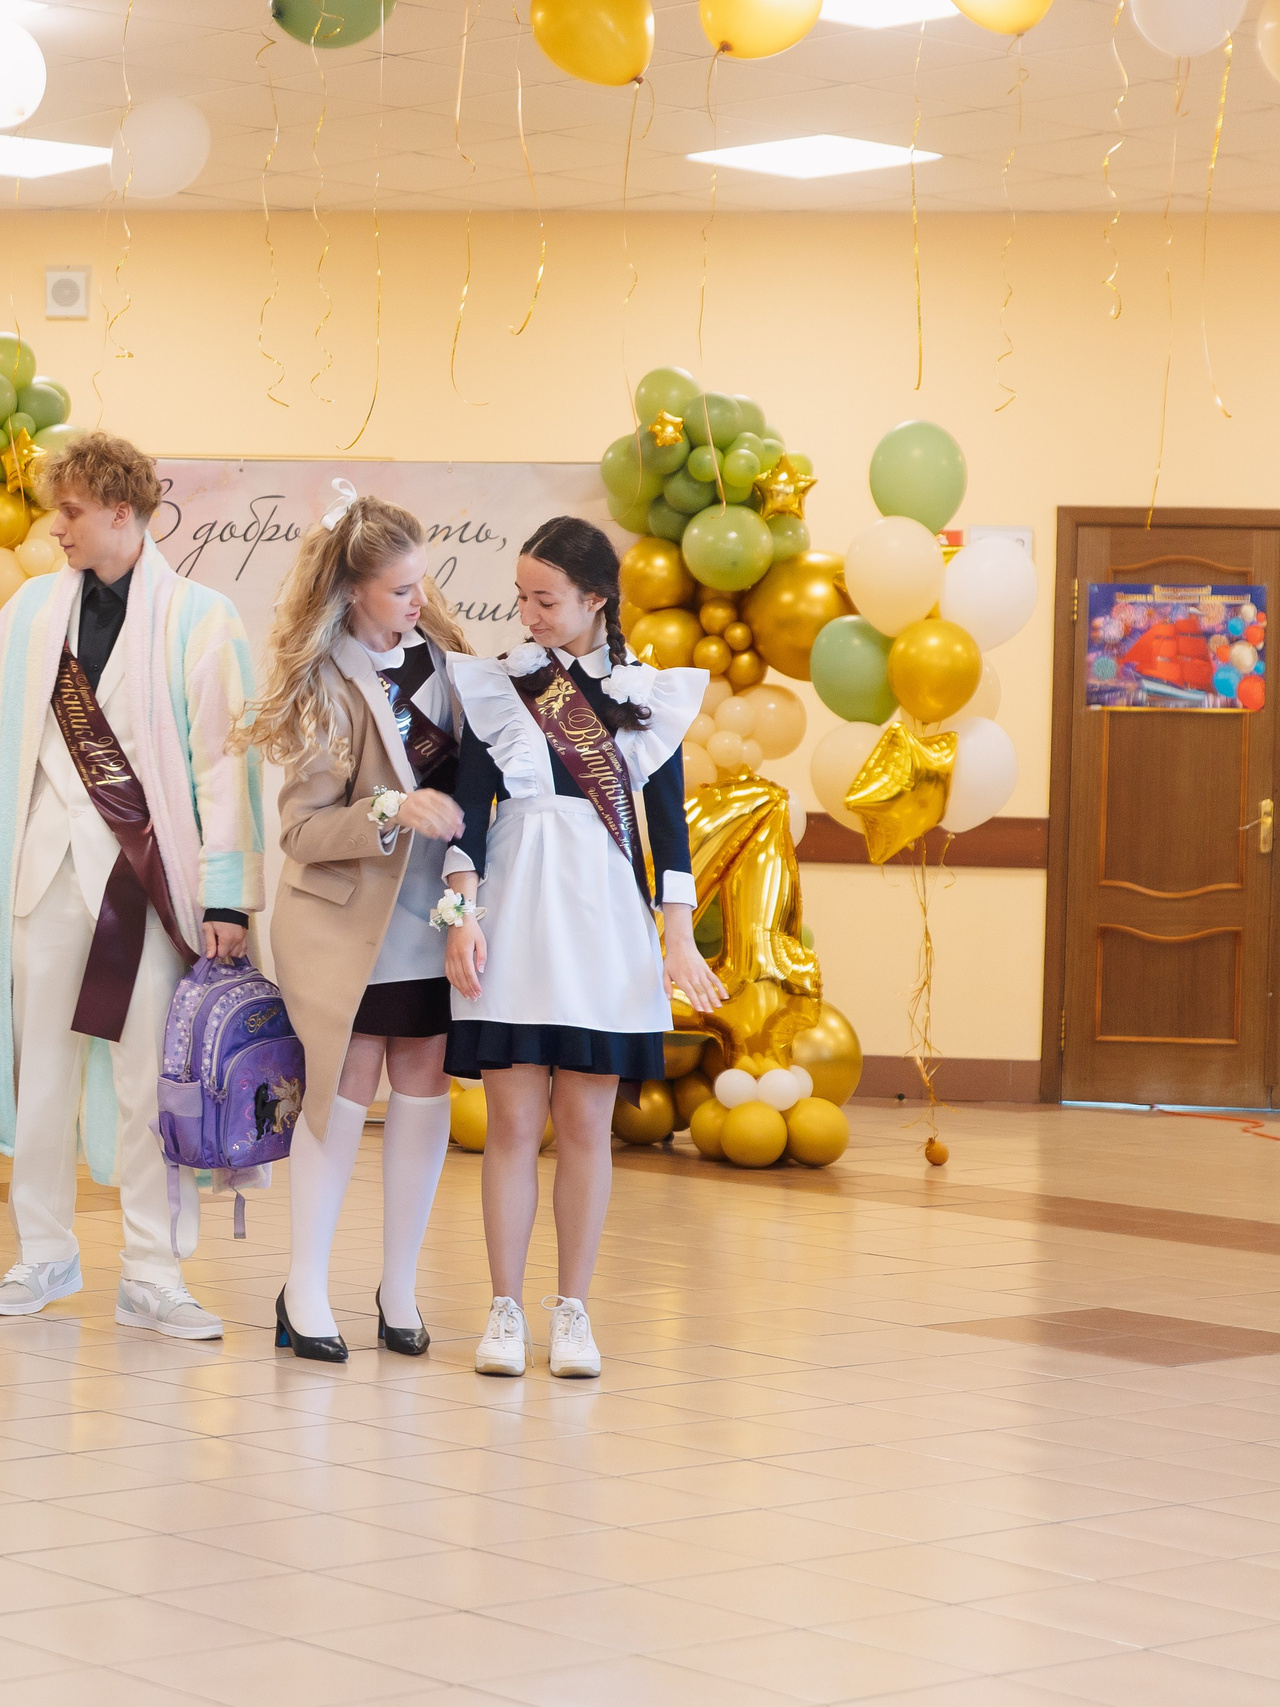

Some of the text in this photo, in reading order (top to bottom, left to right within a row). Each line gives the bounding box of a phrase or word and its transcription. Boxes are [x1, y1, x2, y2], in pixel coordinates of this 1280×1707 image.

[176, 495, 302, 581] добры
[427, 520, 508, 552] ть,
[78, 736, 132, 787] 2024
